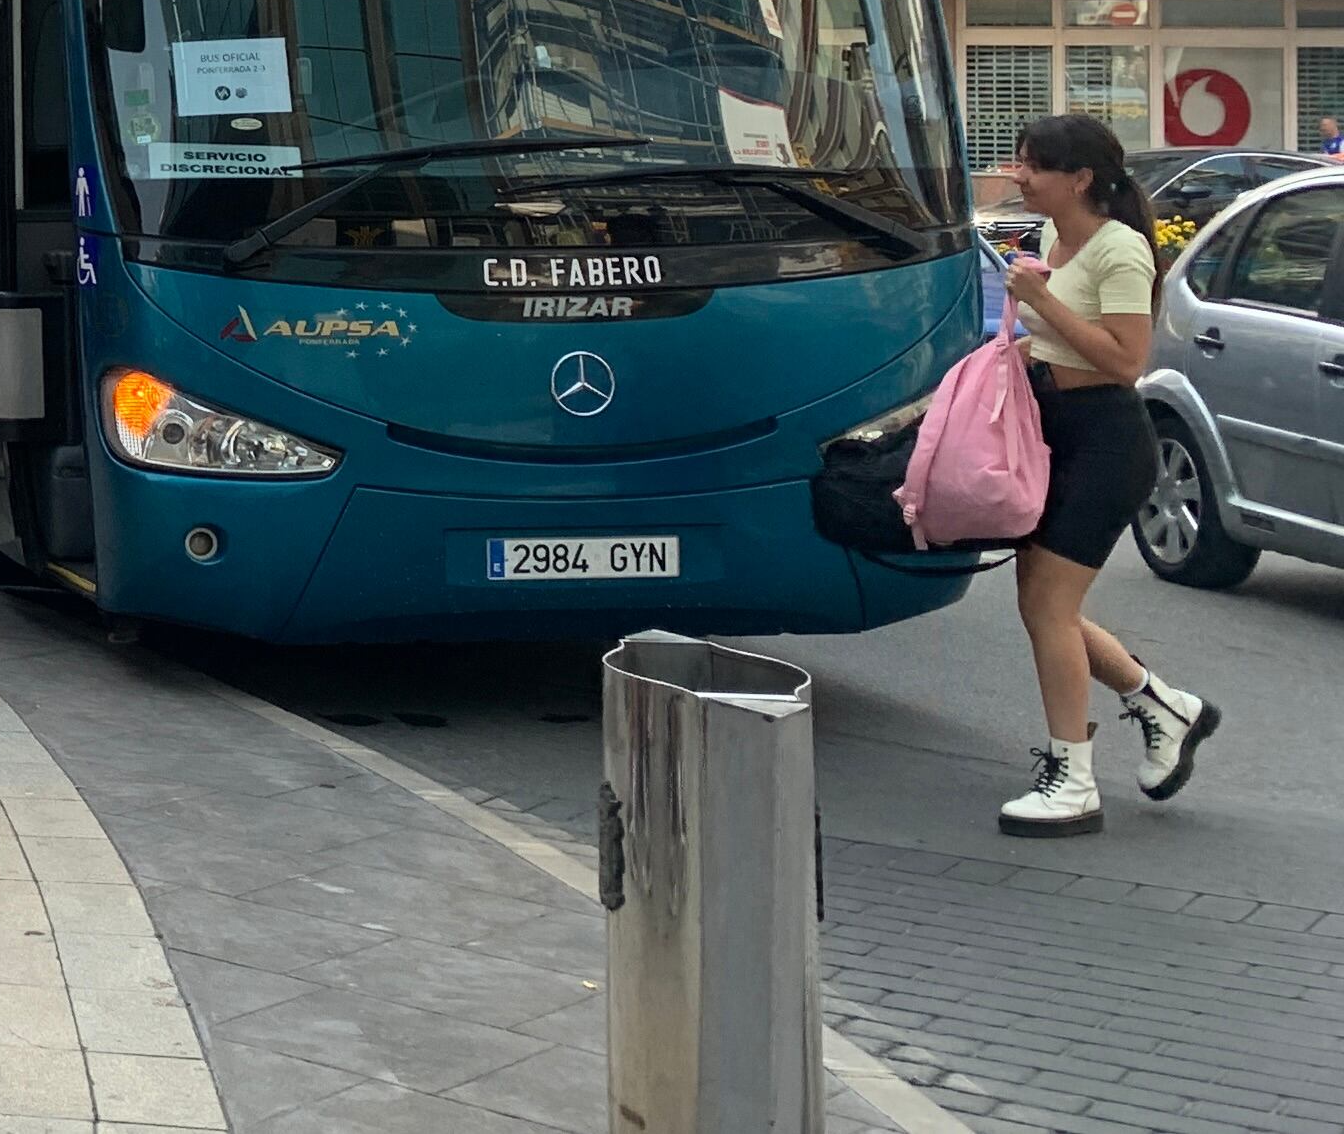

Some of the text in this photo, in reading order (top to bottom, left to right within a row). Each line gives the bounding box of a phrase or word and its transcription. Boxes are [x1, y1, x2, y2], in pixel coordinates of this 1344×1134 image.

[200, 51, 261, 63] BUS OFICIAL
[183, 151, 267, 163] SERVICIO
[160, 163, 294, 177] DISCRECIONAL
[483, 254, 662, 288] C.D. FABERO
[523, 296, 634, 318] IRIZAR
[263, 320, 400, 337] AUPSA
[513, 543, 590, 574] 2984
[610, 541, 667, 573] GYN
